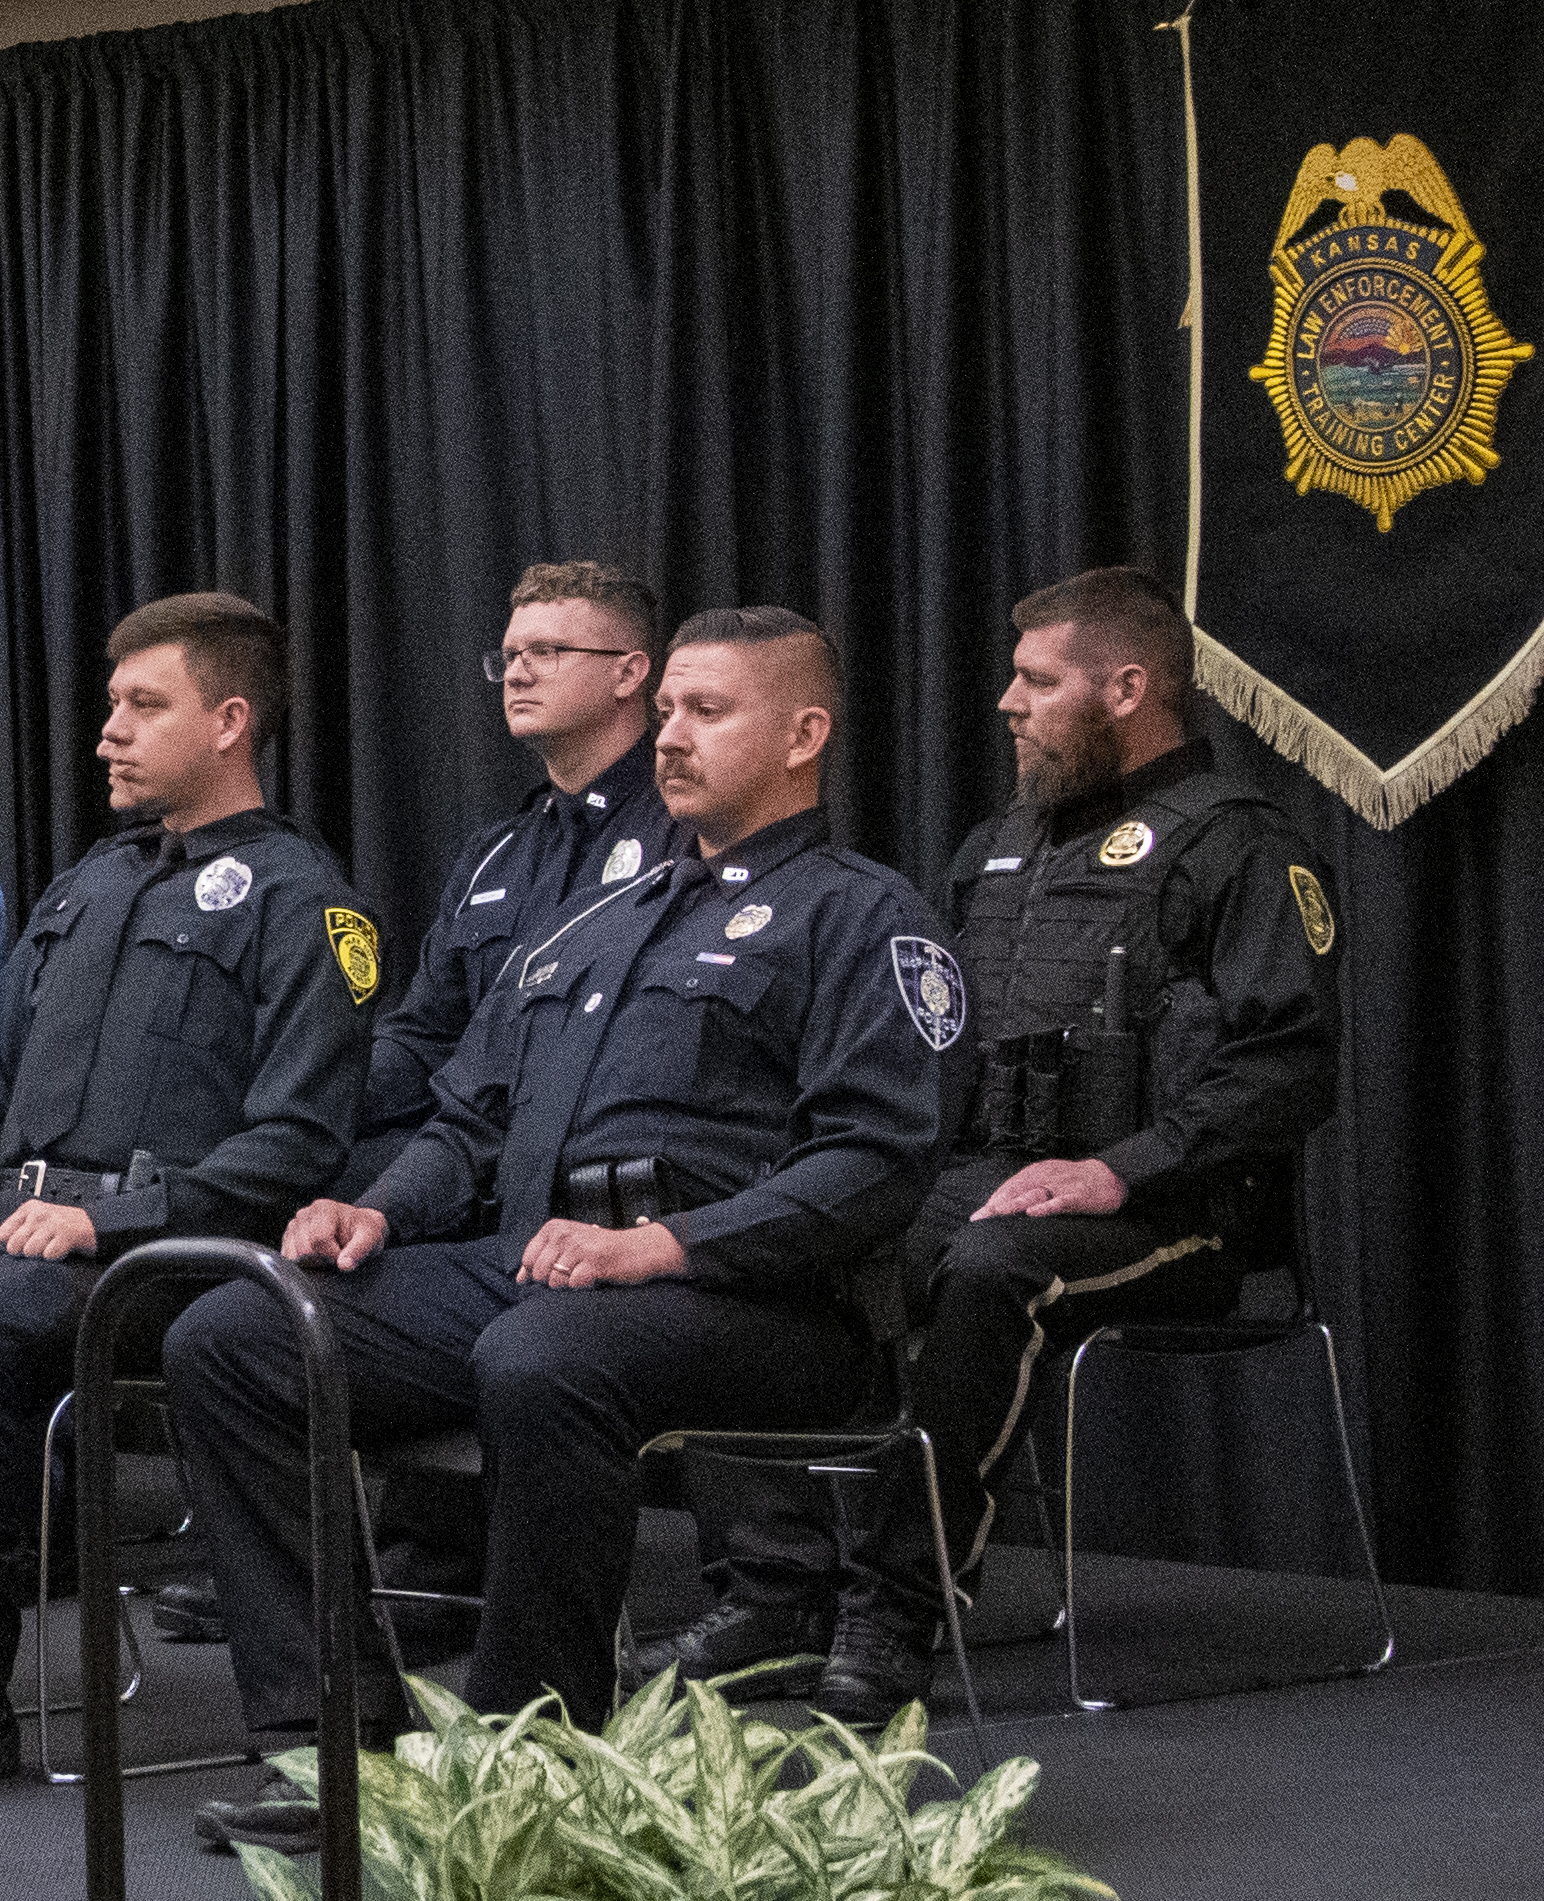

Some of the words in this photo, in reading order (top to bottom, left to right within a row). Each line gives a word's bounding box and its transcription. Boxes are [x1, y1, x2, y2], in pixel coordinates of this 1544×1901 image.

[1312, 238, 1422, 269] KANSAS
[1297, 313, 1323, 360] LAW
[1319, 275, 1455, 354] ENFORCEMENT
[1302, 381, 1385, 457] TRAINING
[1395, 373, 1456, 453] CENTER
